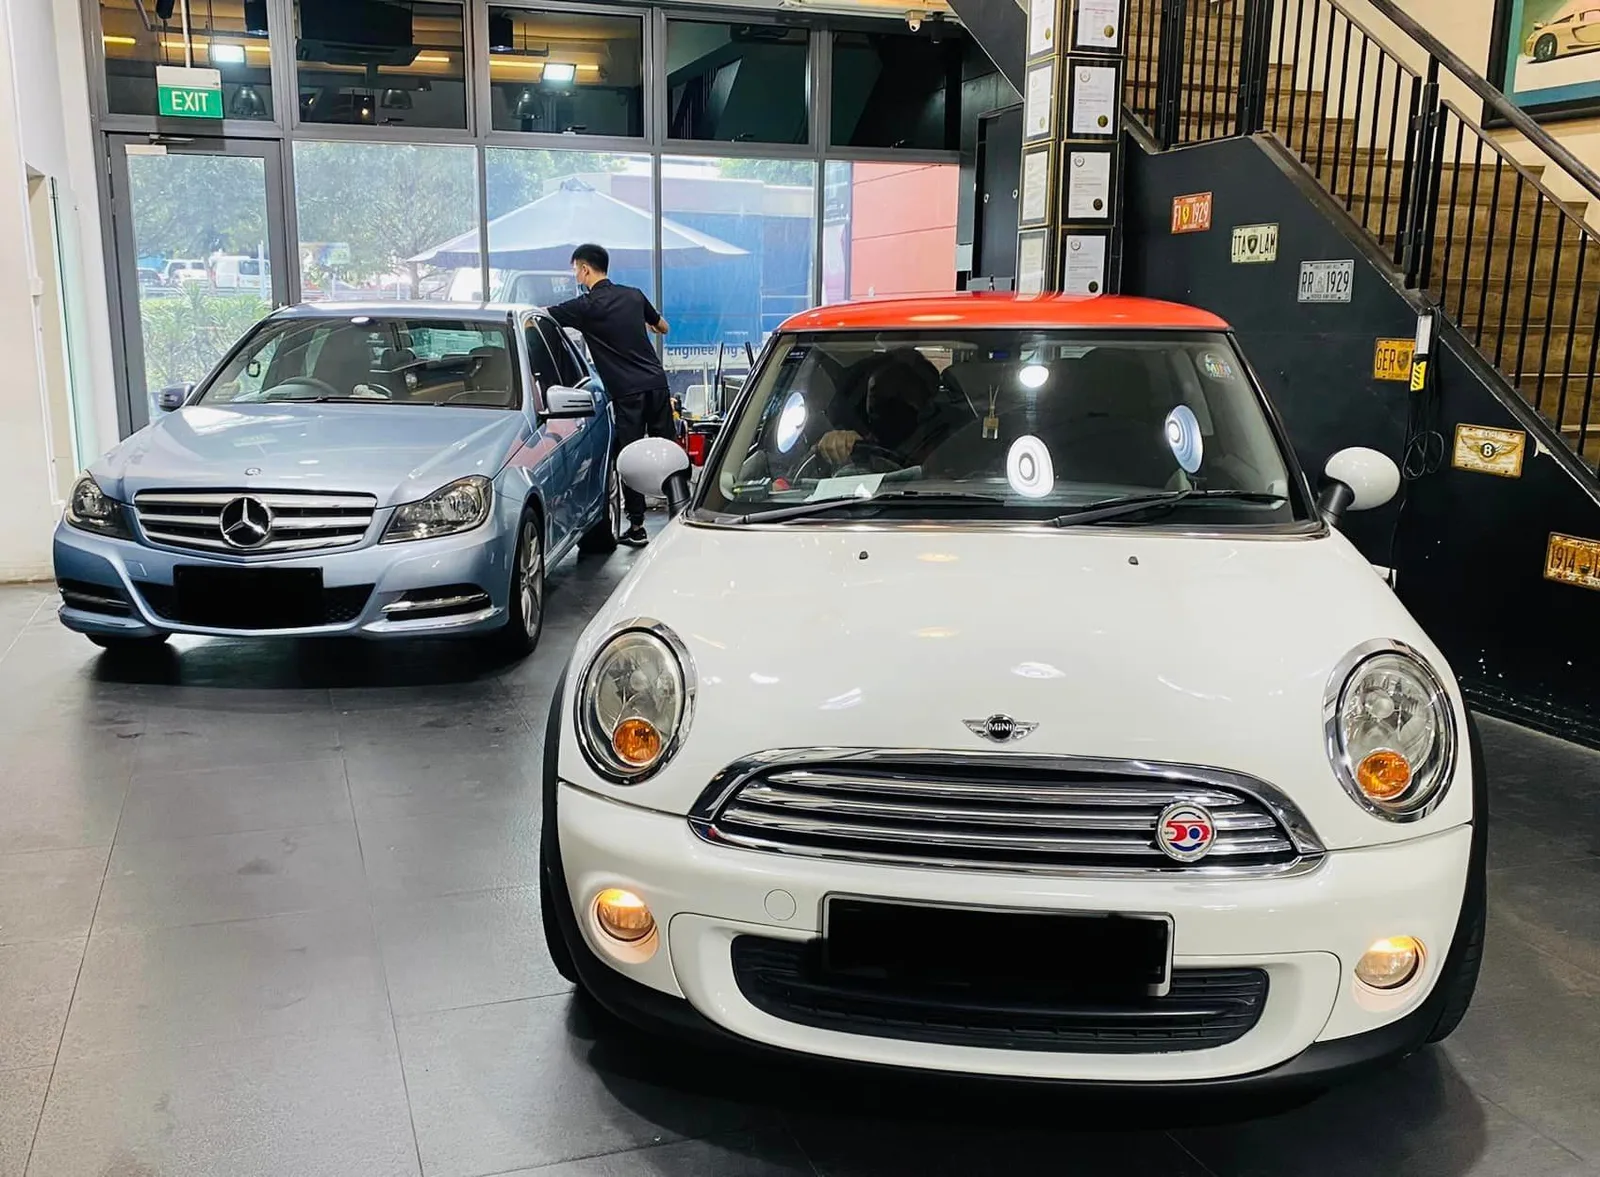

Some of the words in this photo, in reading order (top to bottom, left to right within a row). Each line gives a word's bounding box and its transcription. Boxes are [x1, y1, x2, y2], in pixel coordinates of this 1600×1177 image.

[171, 90, 209, 112] EXIT
[1301, 271, 1314, 293] RR
[1326, 270, 1349, 293] 1929
[667, 346, 737, 359] Engineerng
[1376, 348, 1396, 371] GER
[1550, 545, 1576, 573] 1914
[988, 722, 1012, 732] MINI
[1166, 820, 1210, 842] 50
